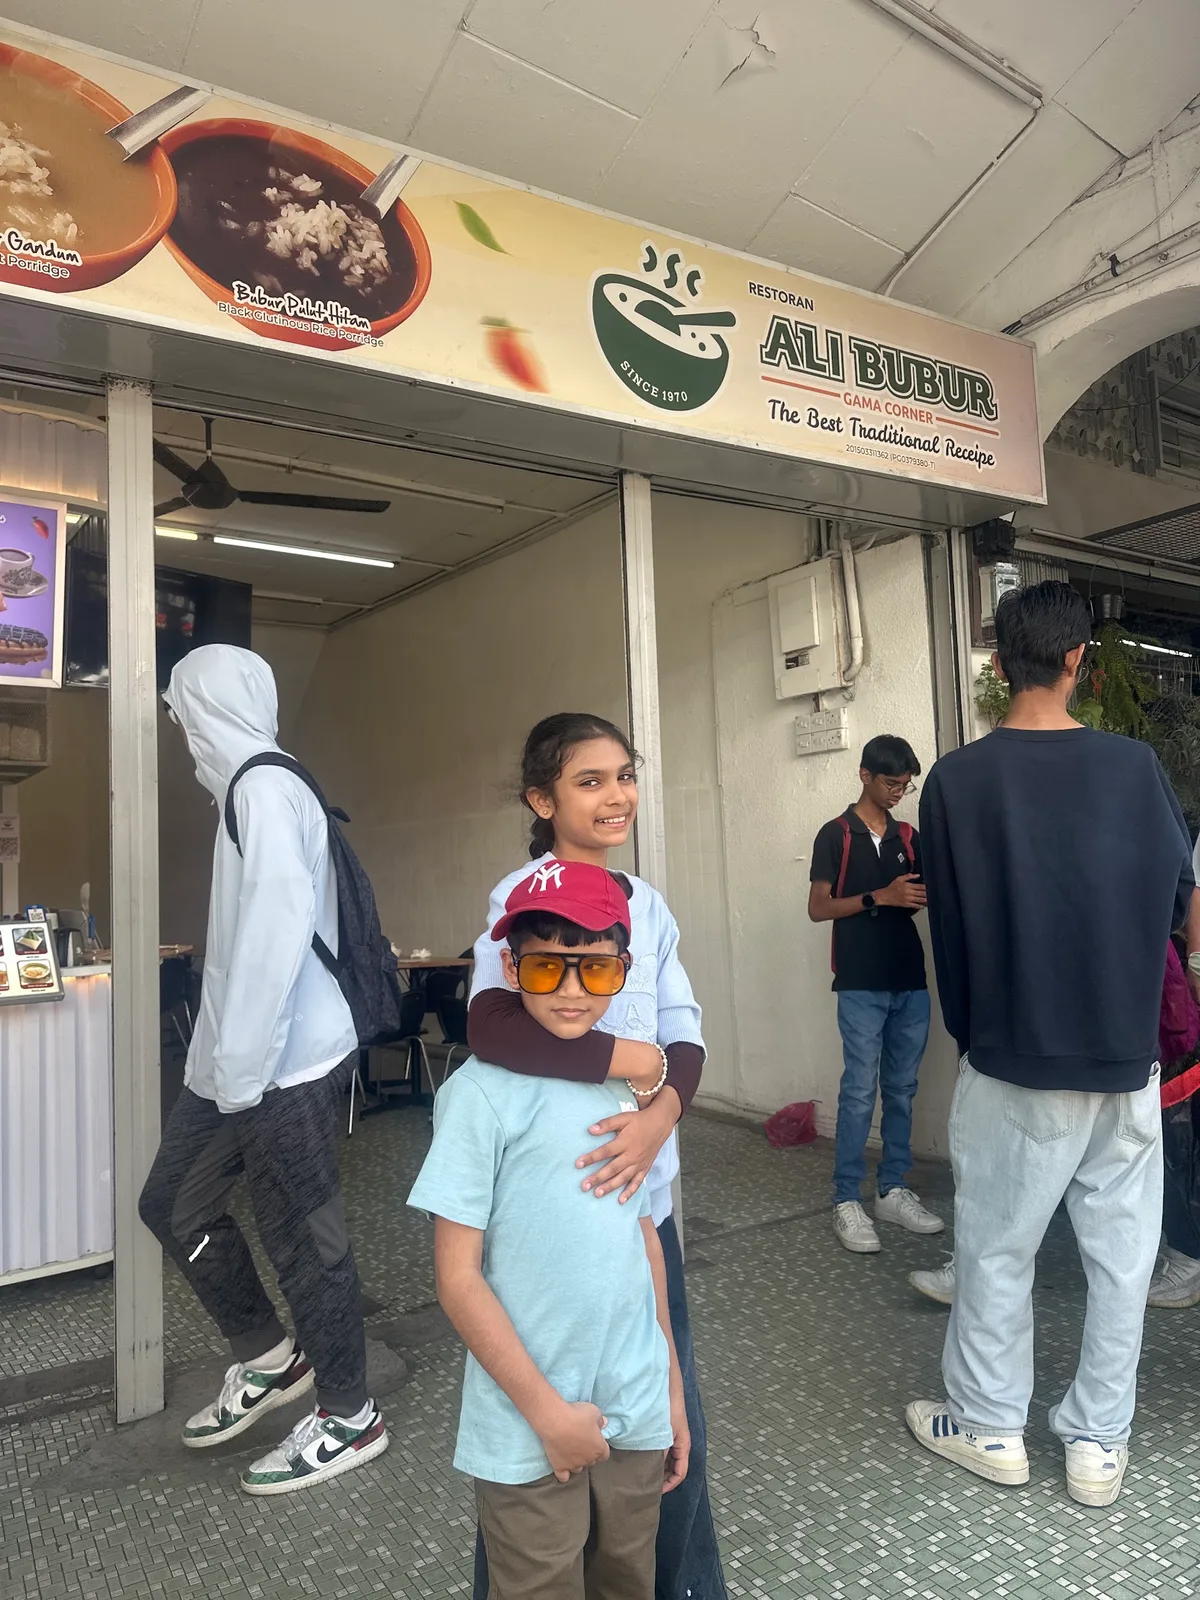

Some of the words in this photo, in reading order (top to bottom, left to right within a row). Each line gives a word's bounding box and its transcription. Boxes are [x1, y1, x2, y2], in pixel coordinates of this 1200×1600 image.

[7, 230, 80, 263] Gandum
[8, 255, 69, 277] Porridge
[235, 283, 283, 310] Bubur
[286, 295, 325, 318] Pulut
[326, 301, 370, 330] Hitam
[748, 281, 814, 311] RESTORAN
[218, 302, 252, 318] Black
[254, 311, 310, 331] Glutinous
[312, 323, 336, 337] Rice
[338, 329, 384, 347] Porridge
[620, 360, 659, 398] SINCE
[661, 390, 688, 402] 1970
[759, 314, 846, 383] ALI
[848, 335, 998, 421] BUBUR
[843, 392, 882, 413] GAMA
[884, 401, 934, 425] CORNER
[768, 398, 801, 424] The
[806, 407, 844, 433] Best
[848, 416, 941, 454] Traditional
[944, 438, 995, 470] Receipe
